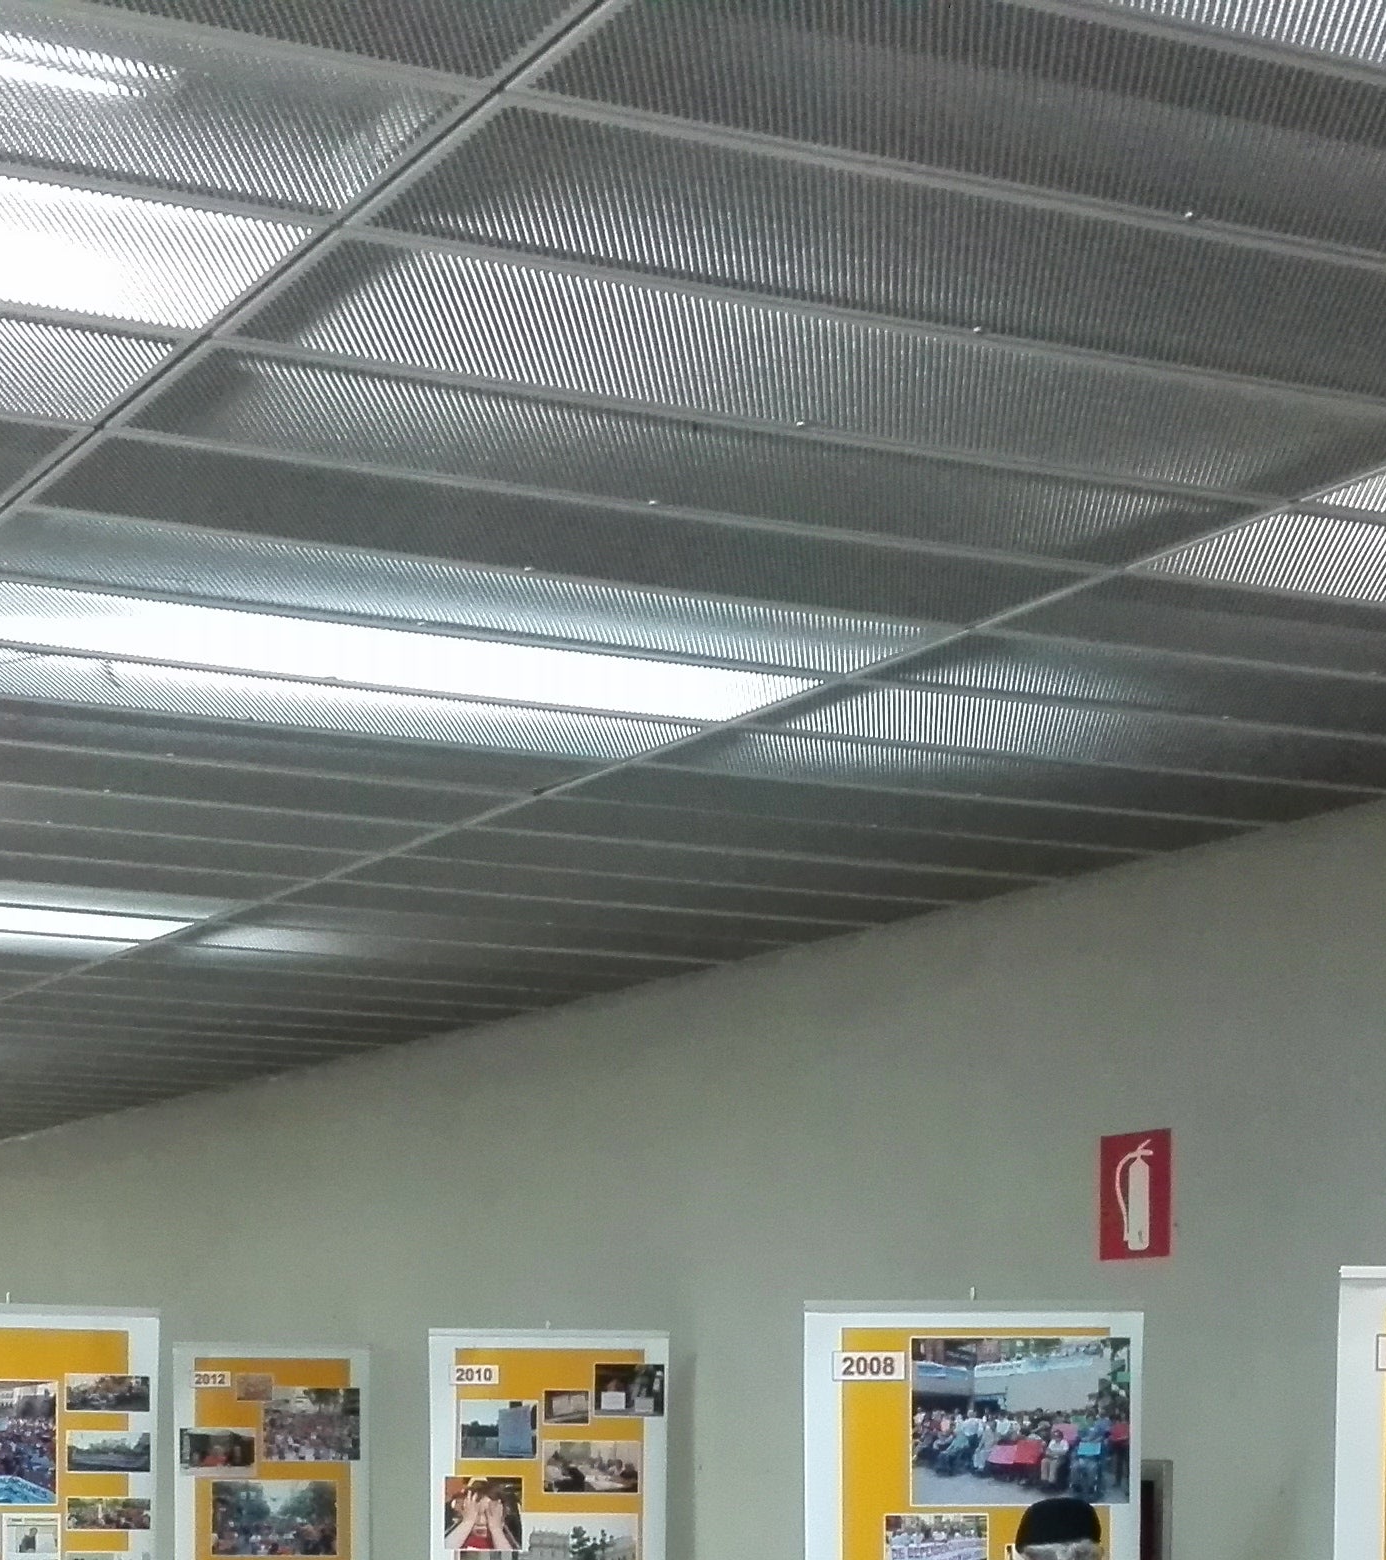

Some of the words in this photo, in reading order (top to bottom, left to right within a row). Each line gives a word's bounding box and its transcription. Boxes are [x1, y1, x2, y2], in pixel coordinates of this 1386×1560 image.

[842, 1356, 895, 1375] 2008
[194, 1373, 226, 1385] 2012
[456, 1367, 493, 1382] 2010
